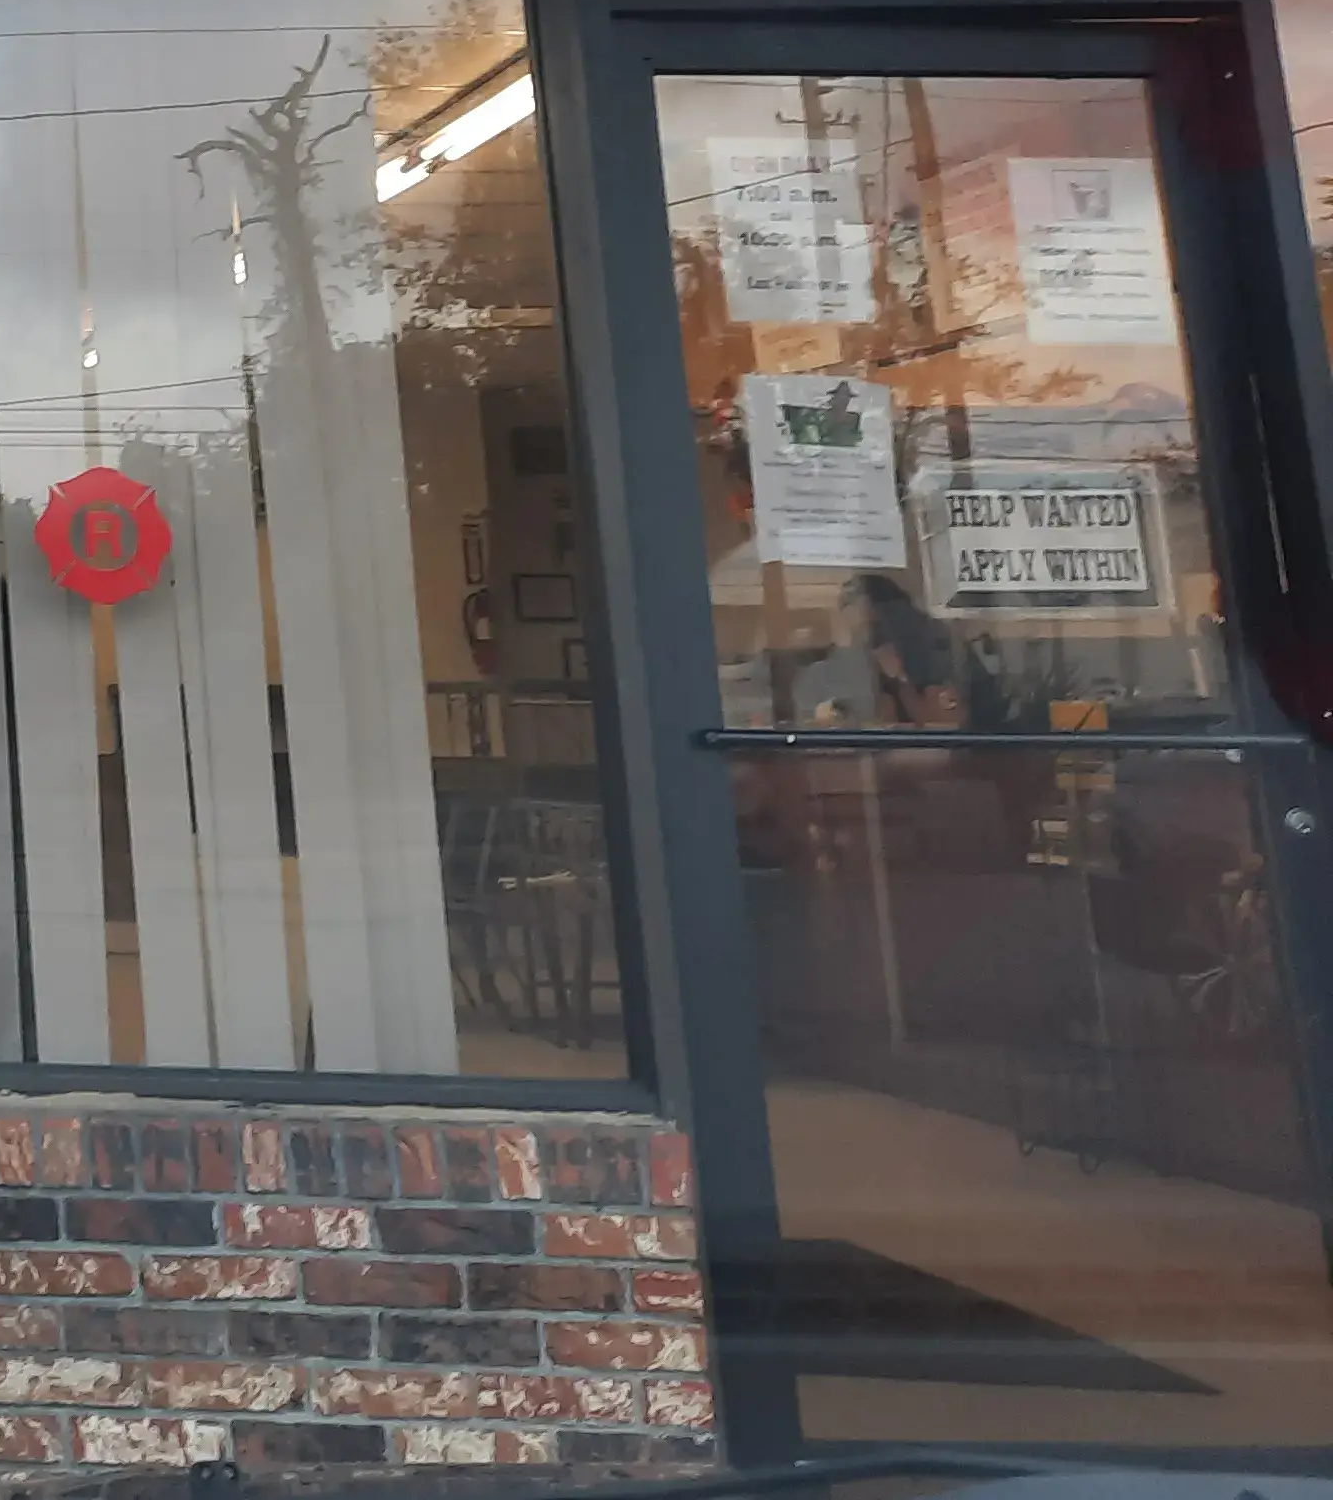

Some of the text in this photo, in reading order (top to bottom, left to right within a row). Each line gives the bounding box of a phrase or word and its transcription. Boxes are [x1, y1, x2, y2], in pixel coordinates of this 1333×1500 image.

[946, 493, 1132, 528] HELP WANTED
[957, 547, 1140, 583] APPLY WITHIN
